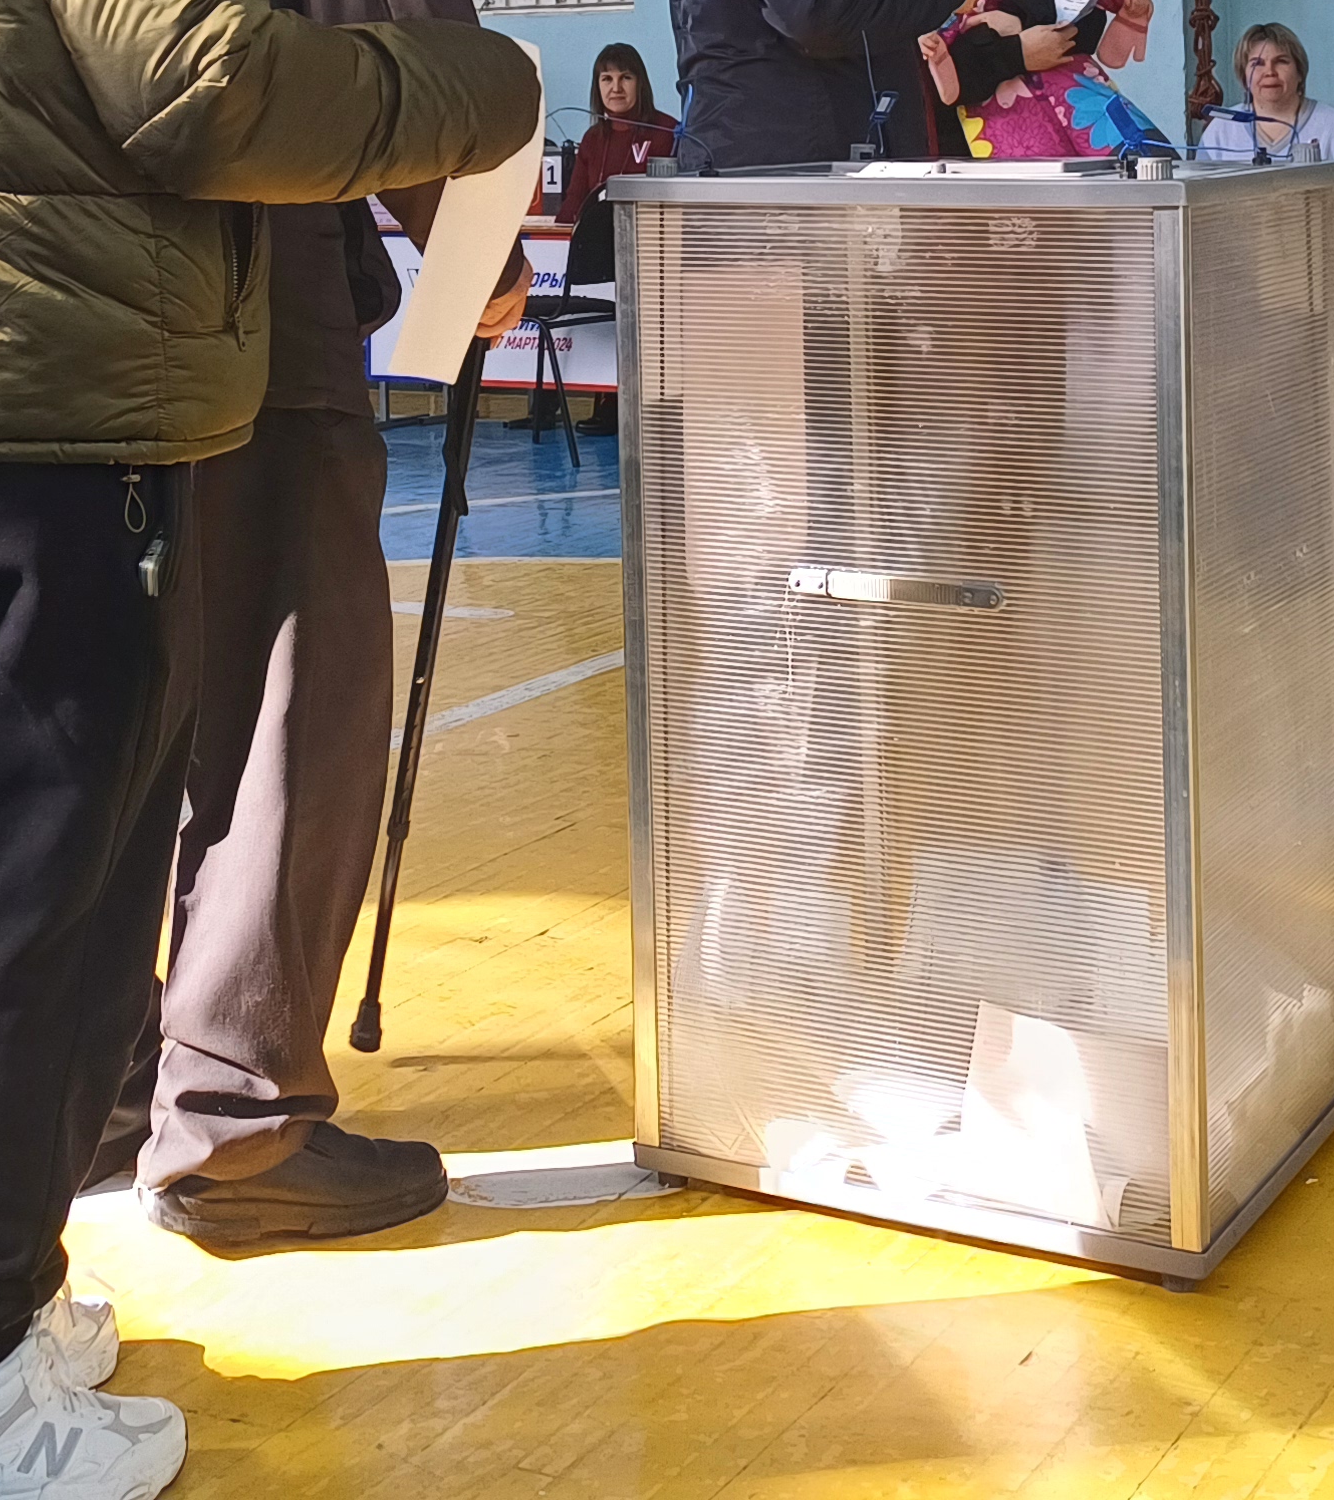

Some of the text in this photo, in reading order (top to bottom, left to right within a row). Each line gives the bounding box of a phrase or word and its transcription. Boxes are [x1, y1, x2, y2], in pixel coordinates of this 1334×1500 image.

[547, 165, 557, 185] 1
[530, 272, 567, 288] ОРЫ
[505, 336, 540, 350] МАРТ
[17, 1421, 83, 1479] N
